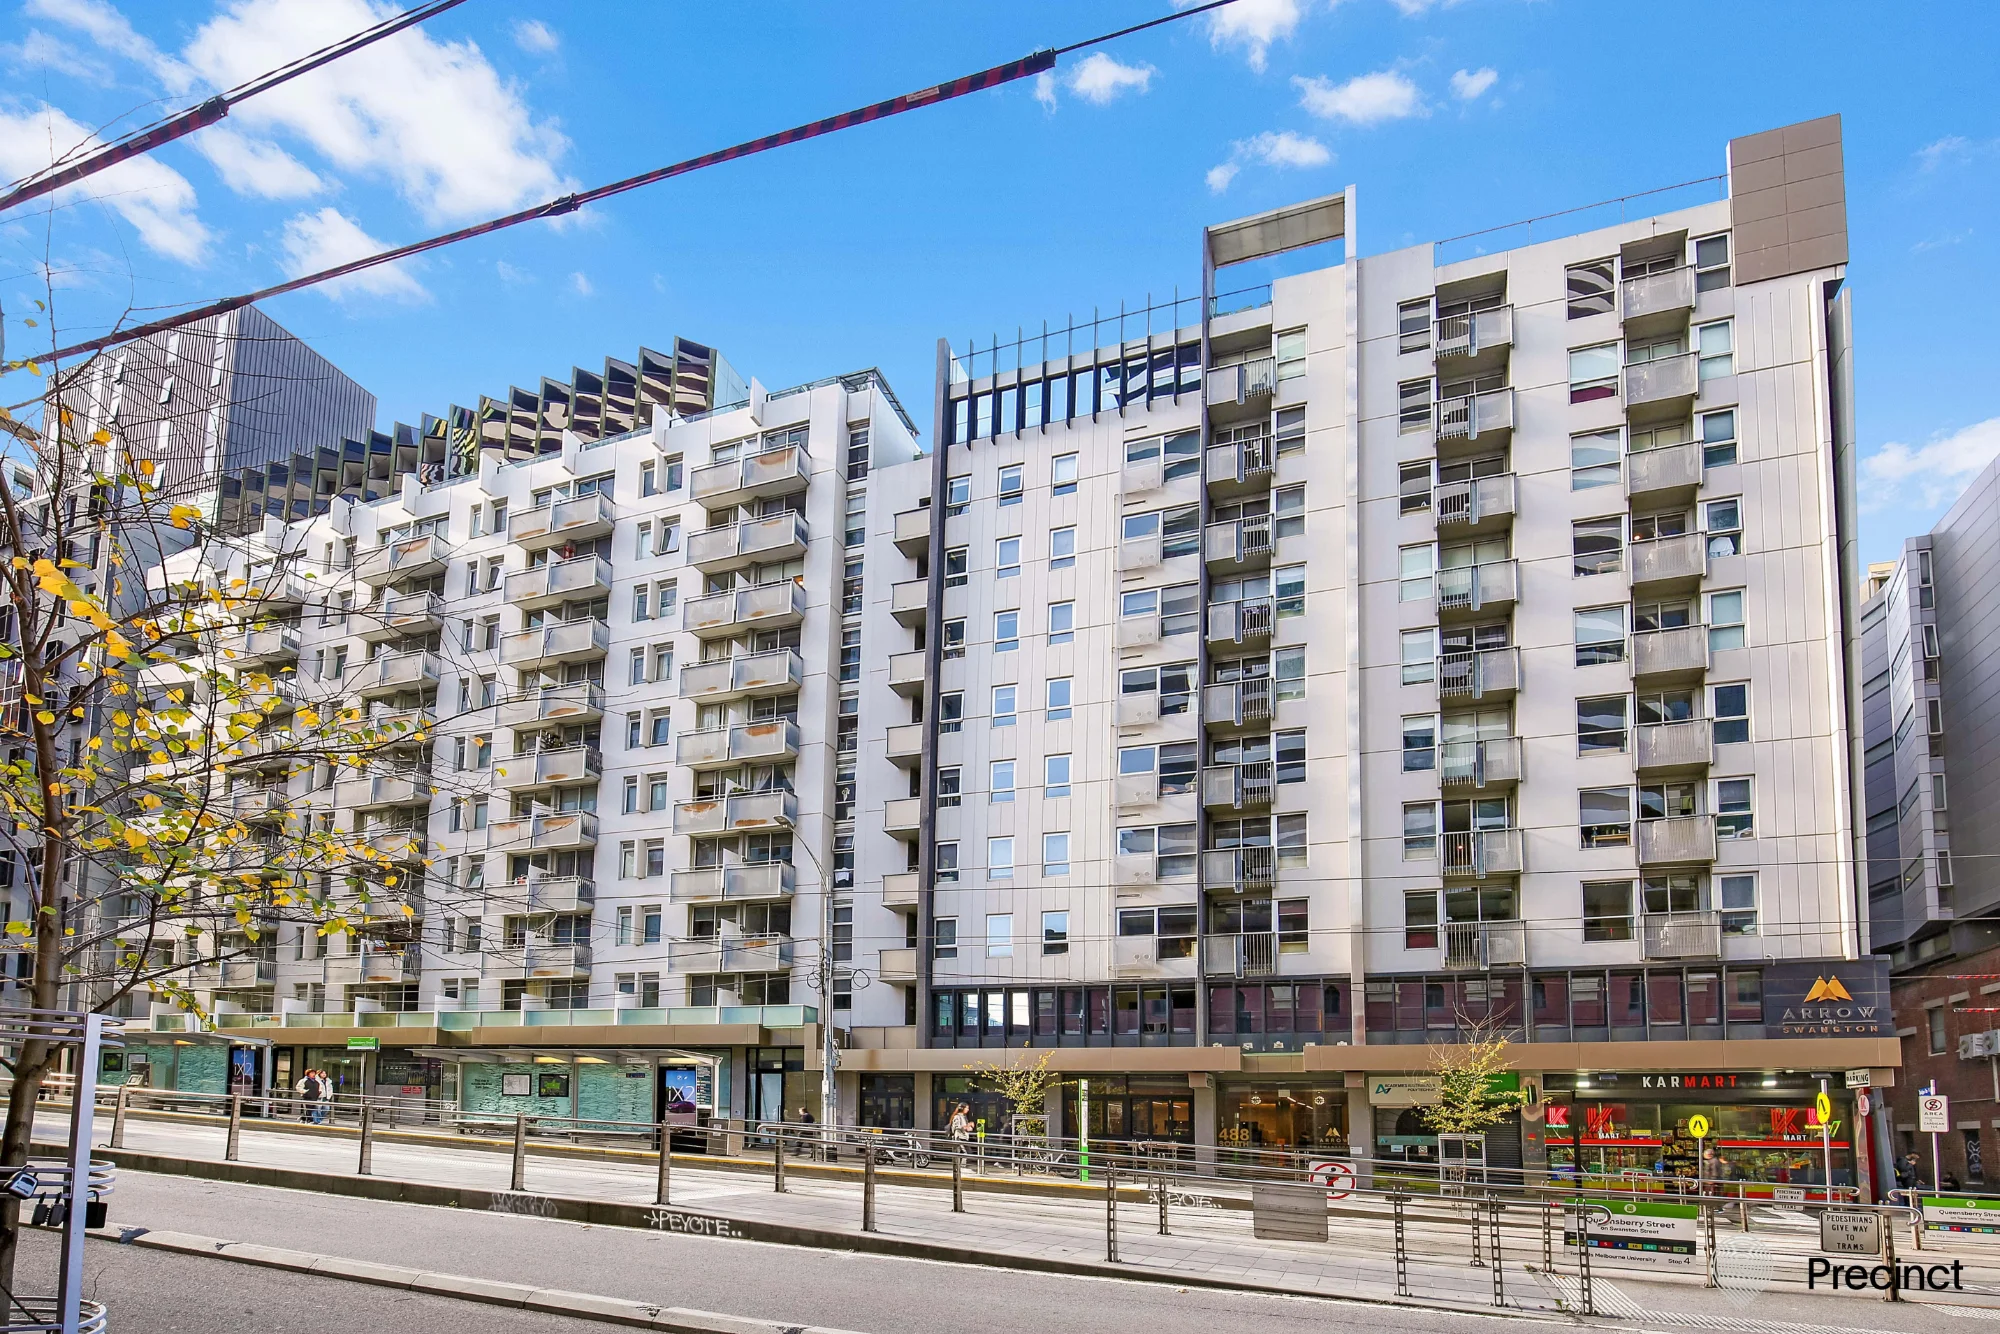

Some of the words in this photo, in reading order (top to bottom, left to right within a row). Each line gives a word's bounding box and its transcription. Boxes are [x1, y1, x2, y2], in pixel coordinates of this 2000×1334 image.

[1782, 1006, 1877, 1020] ARROW
[1782, 1025, 1879, 1034] SWANSTON
[1642, 1075, 1737, 1088] KARMART
[1846, 1073, 1869, 1083] PARKING
[668, 1085, 696, 1102] iX2
[1218, 1128, 1250, 1141] 488
[1939, 1209, 1982, 1217] Queensberry
[1827, 1215, 1873, 1224] PEDESTRIANS
[1646, 1220, 1676, 1229] Street
[1832, 1224, 1849, 1232] GIVE
[1837, 1242, 1864, 1251] TRAMS
[1595, 1252, 1626, 1260] Melbourne
[1626, 1255, 1657, 1264] University
[1683, 1257, 1691, 1265] 4
